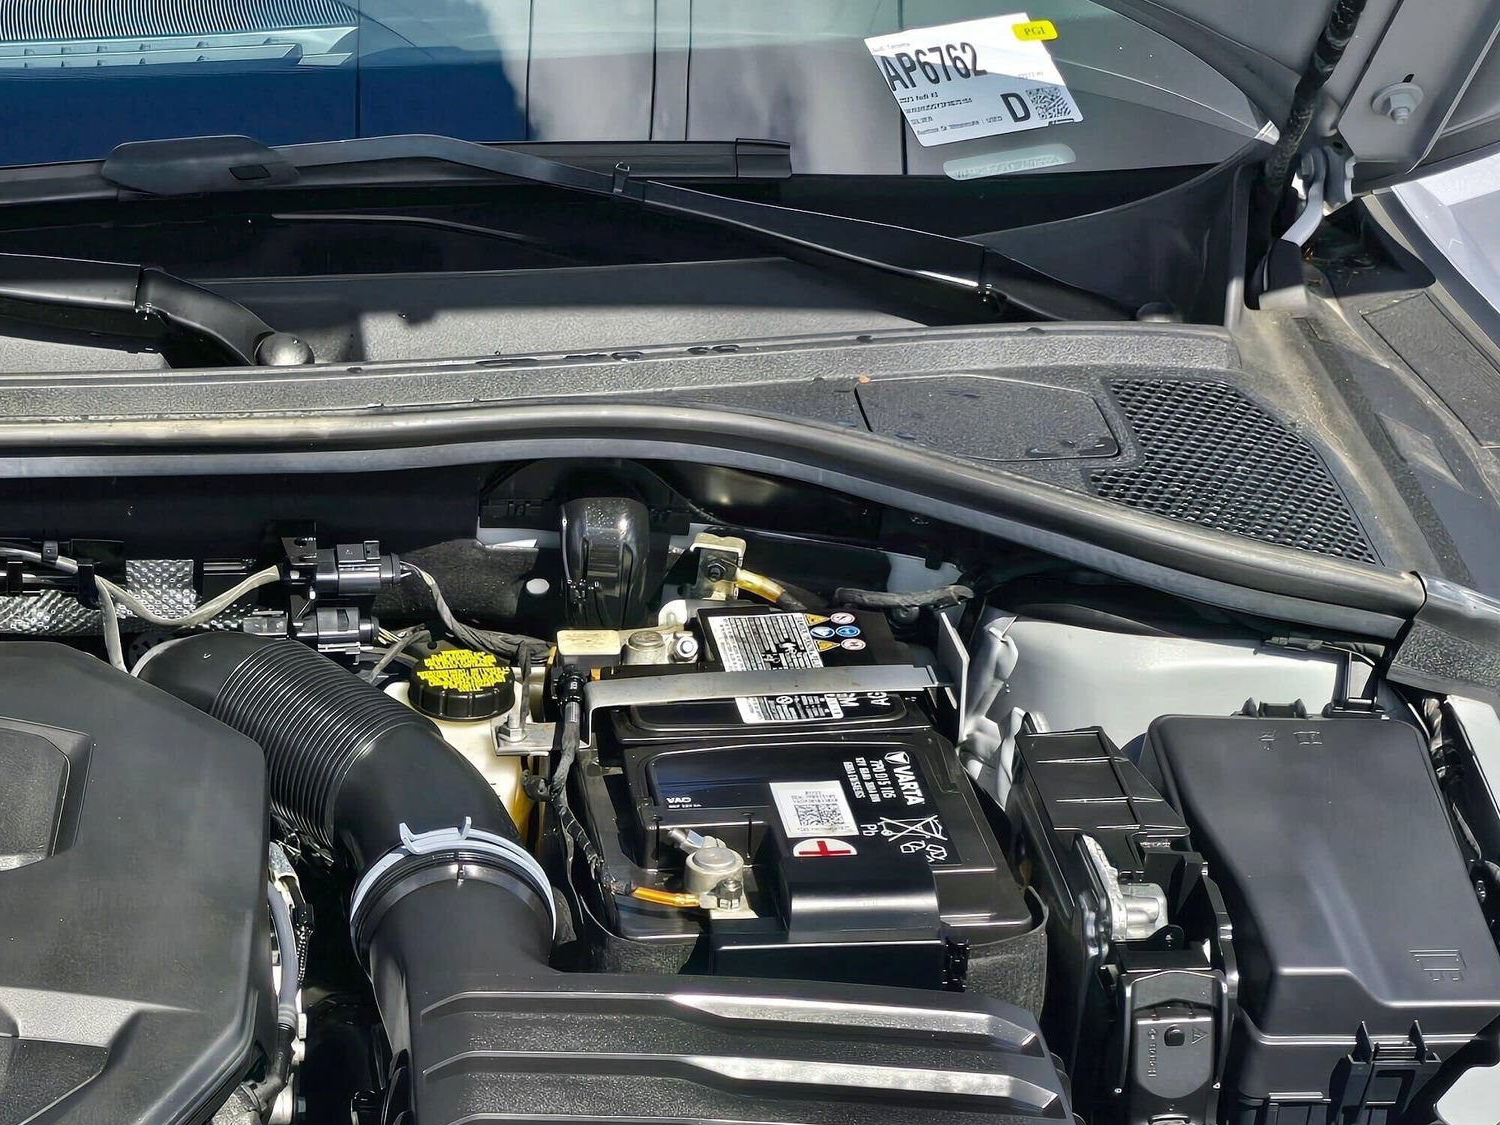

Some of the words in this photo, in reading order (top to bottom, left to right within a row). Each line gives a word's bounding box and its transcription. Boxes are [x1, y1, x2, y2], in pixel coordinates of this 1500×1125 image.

[880, 42, 988, 92] AP6762
[1000, 92, 1031, 122] D
[893, 766, 925, 806] VARTA
[860, 823, 878, 836] Pb
